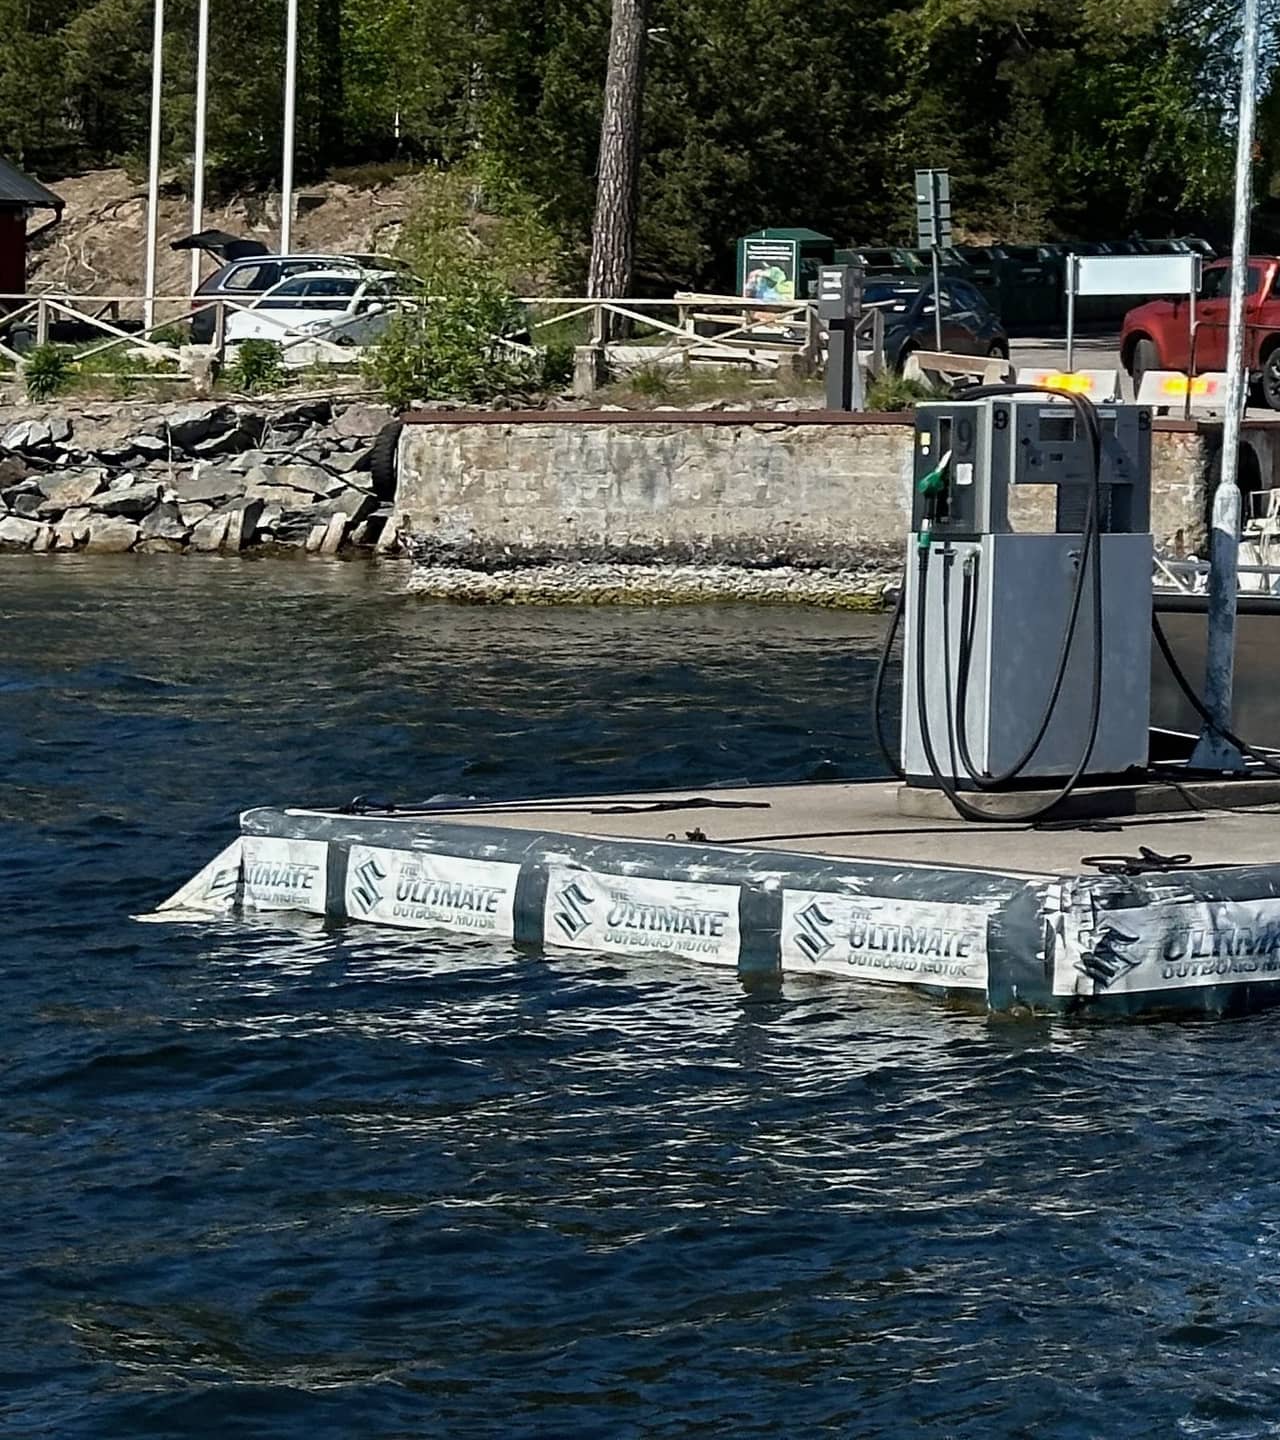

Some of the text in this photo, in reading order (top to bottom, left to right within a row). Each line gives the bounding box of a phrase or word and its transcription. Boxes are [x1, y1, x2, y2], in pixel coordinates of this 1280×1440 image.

[957, 419, 973, 454] 9
[993, 410, 1008, 430] 9
[396, 877, 507, 913] ULTIMATE
[606, 901, 729, 937] ULTIMATE
[849, 921, 979, 958] ULTIMATE
